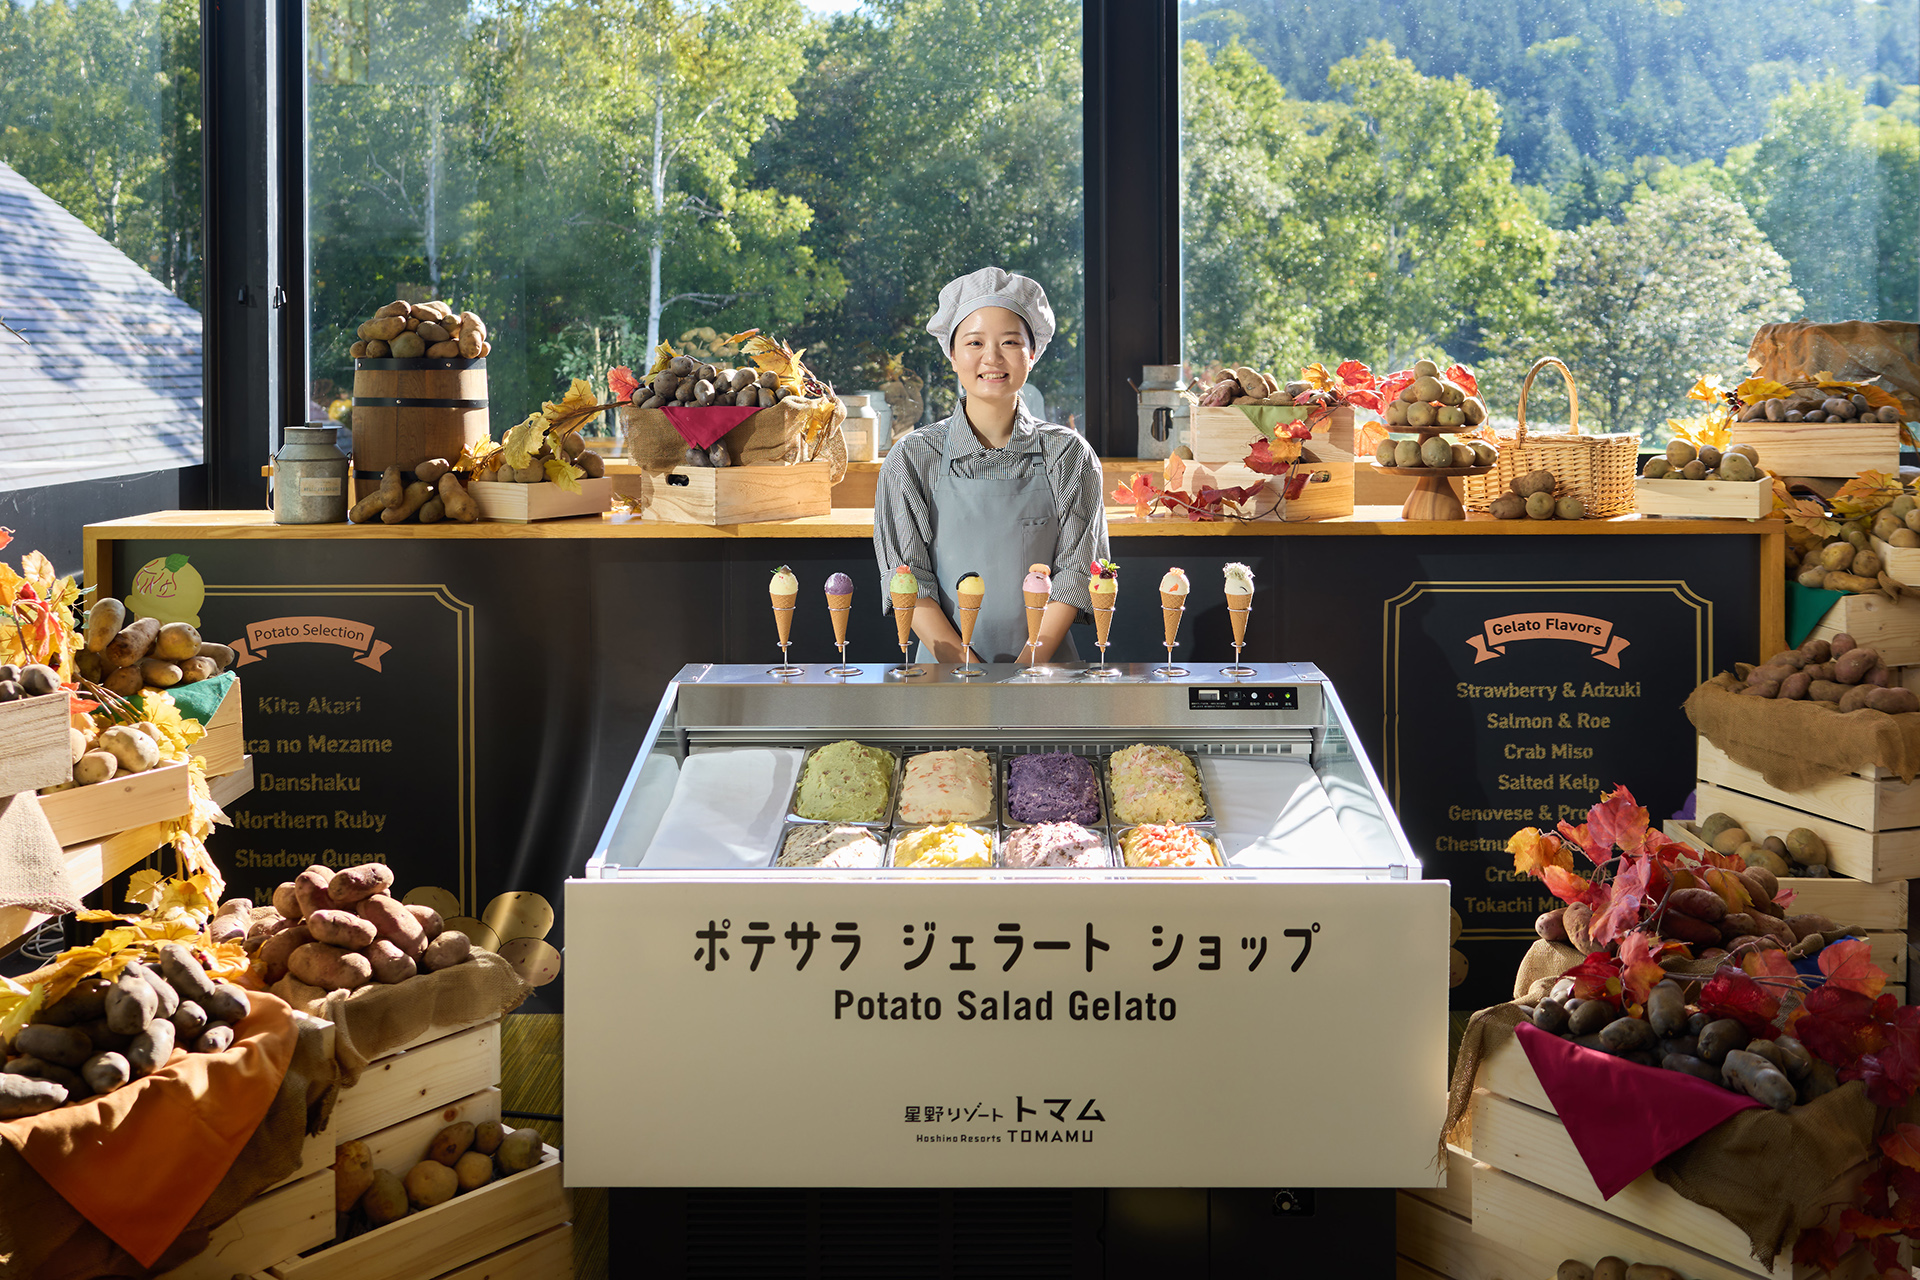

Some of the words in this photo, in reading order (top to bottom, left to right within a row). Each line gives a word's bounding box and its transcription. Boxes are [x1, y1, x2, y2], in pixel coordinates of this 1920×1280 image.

[254, 625, 299, 641] Potato
[303, 624, 365, 641] Selection
[1492, 620, 1541, 635] Gelato
[1545, 618, 1602, 635] Flavors
[1456, 681, 1558, 701] Strawberry
[1562, 681, 1576, 698] &
[1581, 681, 1641, 698] Adzuki
[258, 696, 300, 715] Kita
[306, 696, 361, 715] Akari
[1487, 712, 1553, 729] Salmon
[1558, 712, 1572, 729] &
[1577, 712, 1611, 729] Roe
[276, 739, 301, 753] no
[308, 734, 393, 753] Mezame
[1504, 743, 1546, 760] Crab
[1551, 743, 1594, 760] Miso
[260, 773, 361, 791] Danshaku
[1498, 774, 1554, 790] Salted
[1559, 774, 1600, 793] Kelp
[234, 810, 328, 829] Northern
[334, 810, 386, 833] Ruby
[1448, 805, 1534, 821] Genovese
[1538, 804, 1553, 821] &
[1435, 836, 1510, 852] Chestnu
[235, 849, 317, 868] Shadow
[322, 848, 387, 868] Queen
[1464, 897, 1533, 913] Tokachi
[694, 918, 861, 972] ポテサラ
[903, 921, 1111, 973] ジェラート
[1151, 921, 1321, 973] ショップ
[833, 989, 942, 1020] Potato
[957, 990, 1053, 1020] Salad
[1068, 990, 1177, 1021] Gelato
[904, 1102, 1004, 1122] 星野リゾート
[1016, 1096, 1106, 1122] トマム
[916, 1134, 958, 1143] Hoshino
[960, 1134, 1002, 1143] Resorts
[1007, 1130, 1093, 1143] TOMAMU
